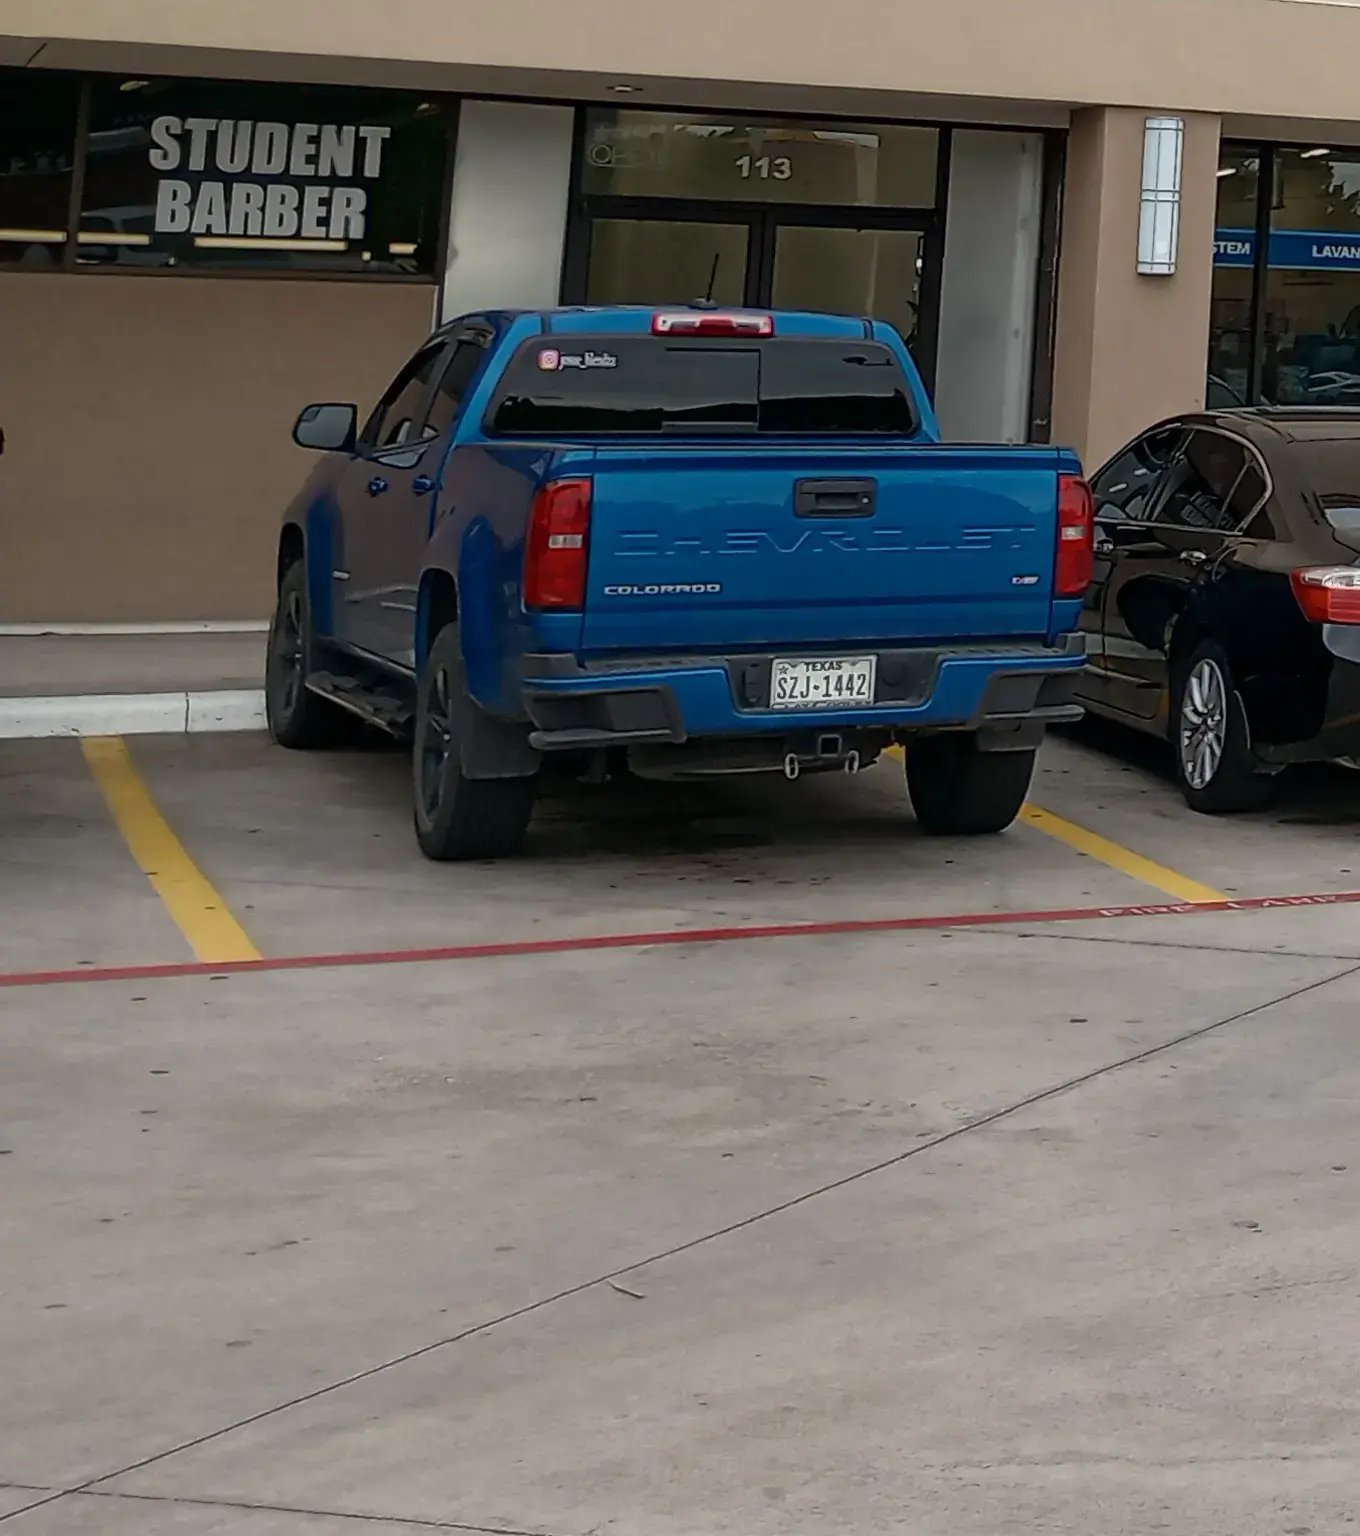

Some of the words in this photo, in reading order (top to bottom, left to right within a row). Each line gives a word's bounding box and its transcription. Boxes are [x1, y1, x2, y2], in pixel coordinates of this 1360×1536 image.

[149, 116, 391, 179] STUDENT
[736, 155, 792, 179] 113
[155, 179, 367, 239] BARBER
[603, 583, 721, 596] COLORADO
[803, 660, 843, 672] TEXAS
